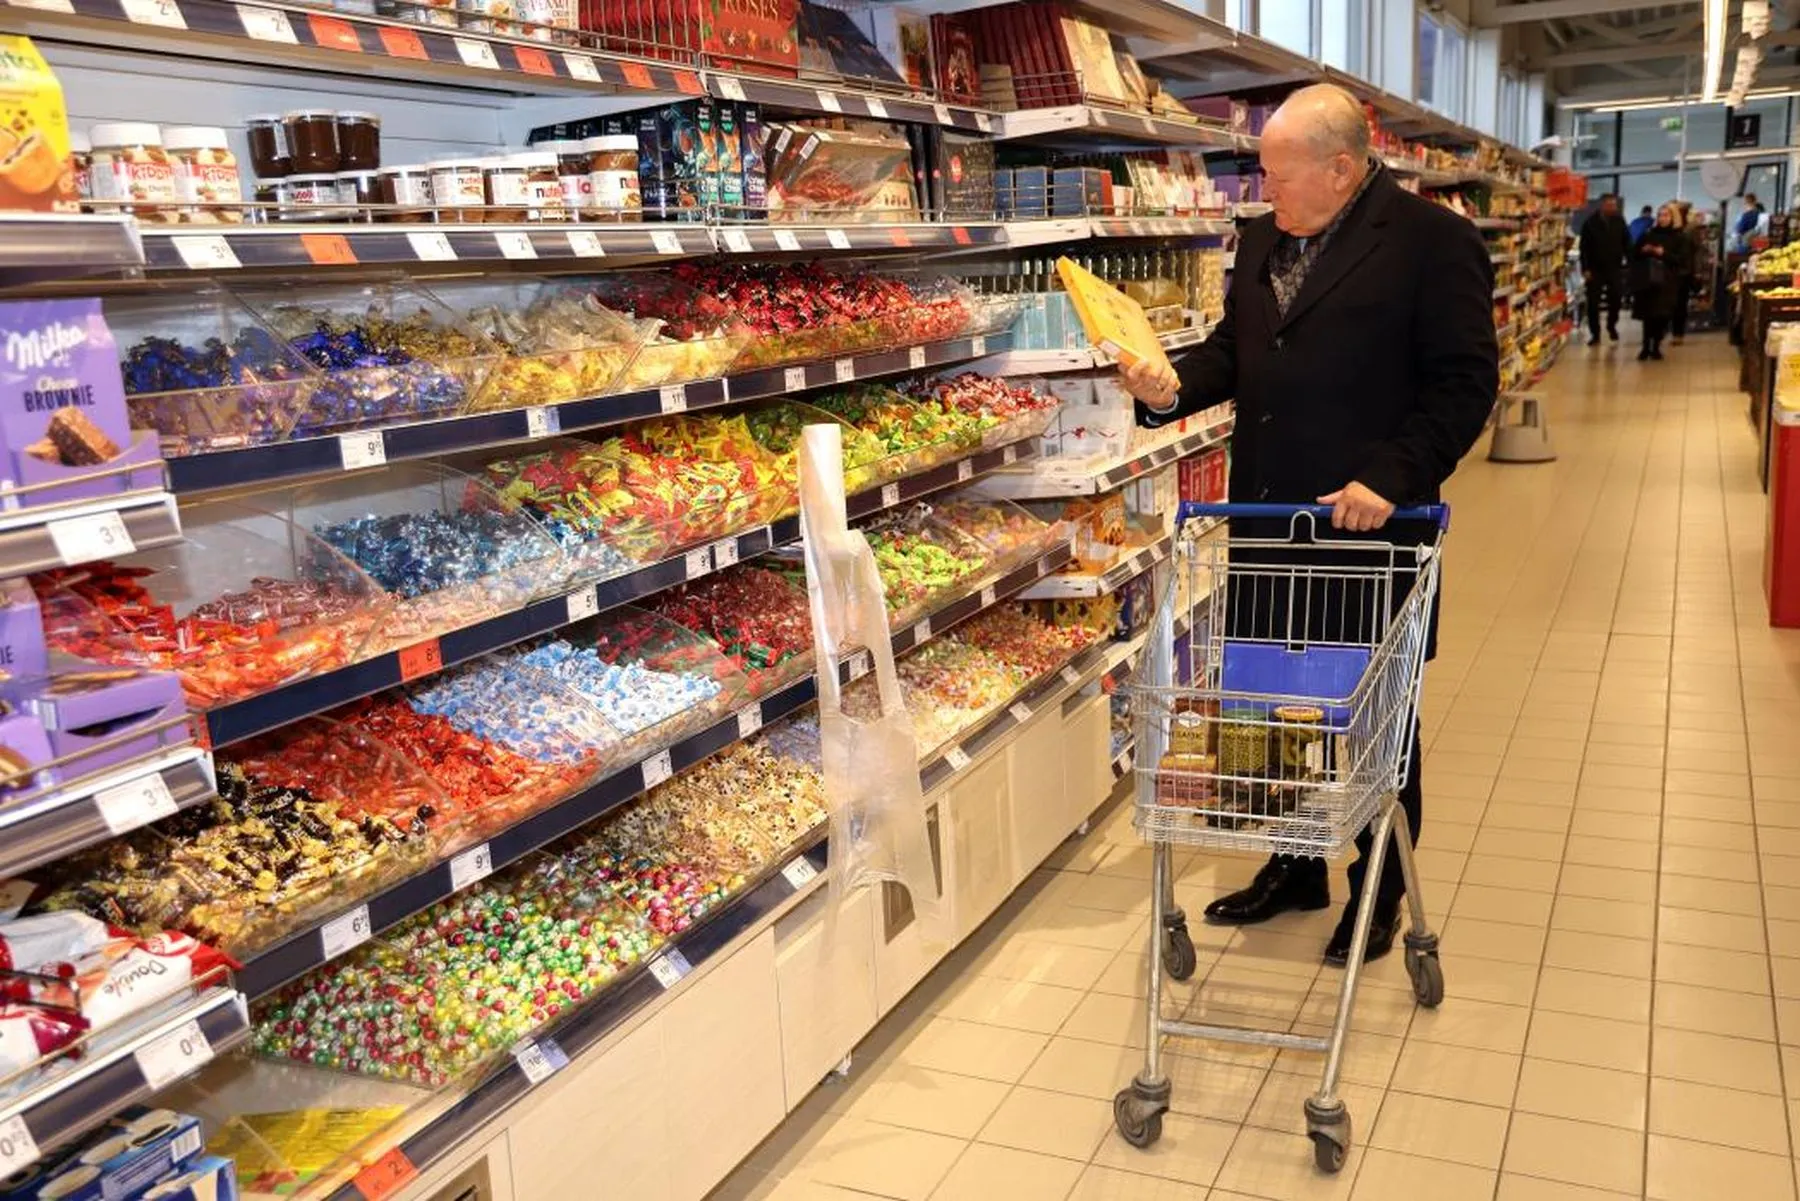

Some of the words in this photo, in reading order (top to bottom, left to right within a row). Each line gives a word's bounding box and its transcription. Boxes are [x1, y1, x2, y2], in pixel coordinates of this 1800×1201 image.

[7, 320, 86, 371] Milka
[23, 384, 96, 412] BROWNIE
[100, 526, 115, 545] 3
[142, 788, 158, 808] 3
[475, 854, 484, 869] 9
[352, 916, 362, 933] 6
[179, 1038, 193, 1056] 0
[2, 1138, 15, 1157] 0
[387, 1160, 402, 1177] 2
